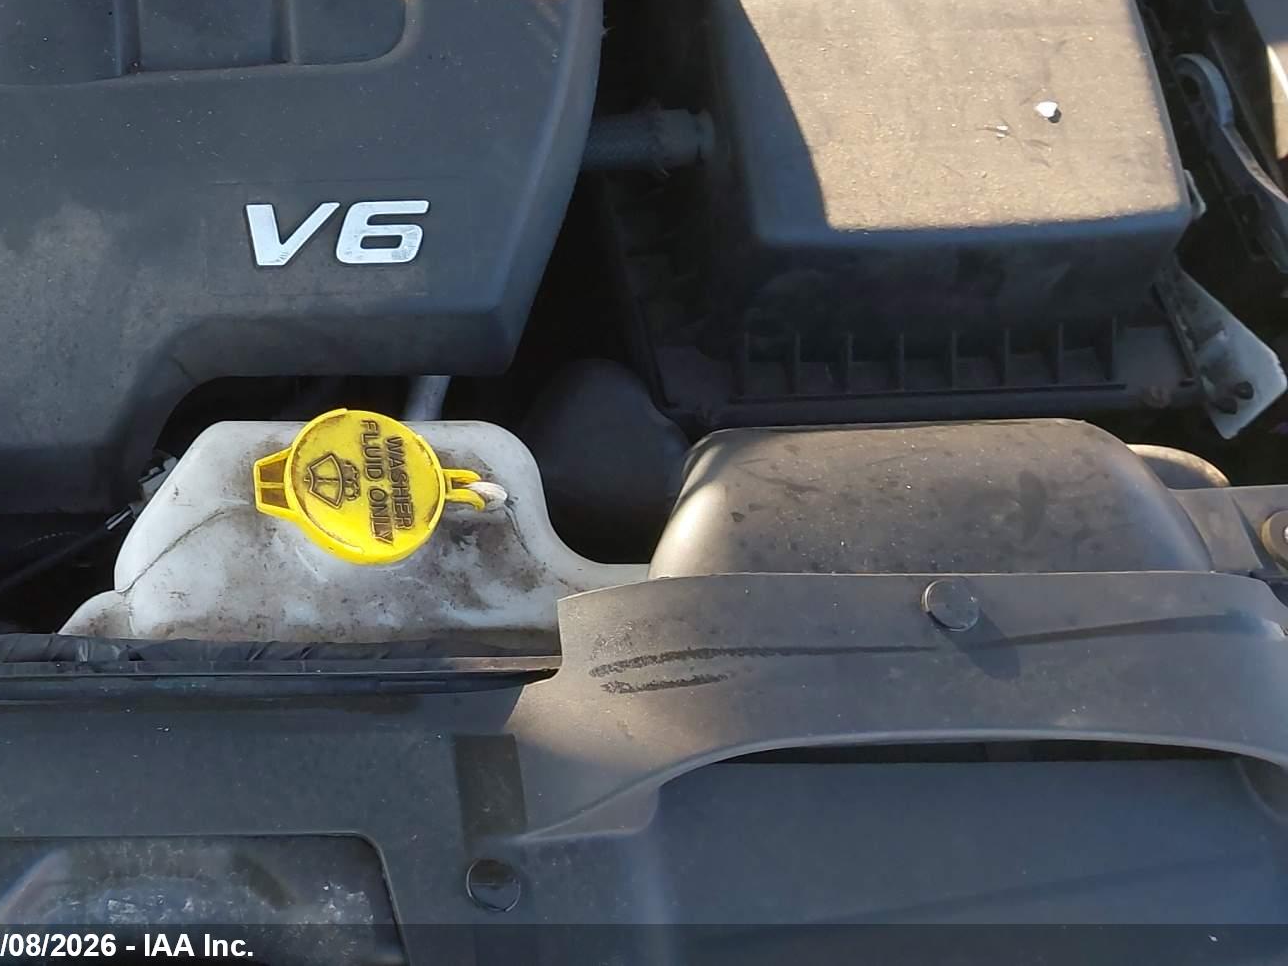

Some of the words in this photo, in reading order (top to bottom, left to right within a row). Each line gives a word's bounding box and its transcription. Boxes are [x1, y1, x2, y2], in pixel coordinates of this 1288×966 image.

[246, 200, 430, 266] V6
[360, 419, 382, 482] FLUID
[384, 435, 413, 531] WASHER
[368, 487, 394, 545] ONLY
